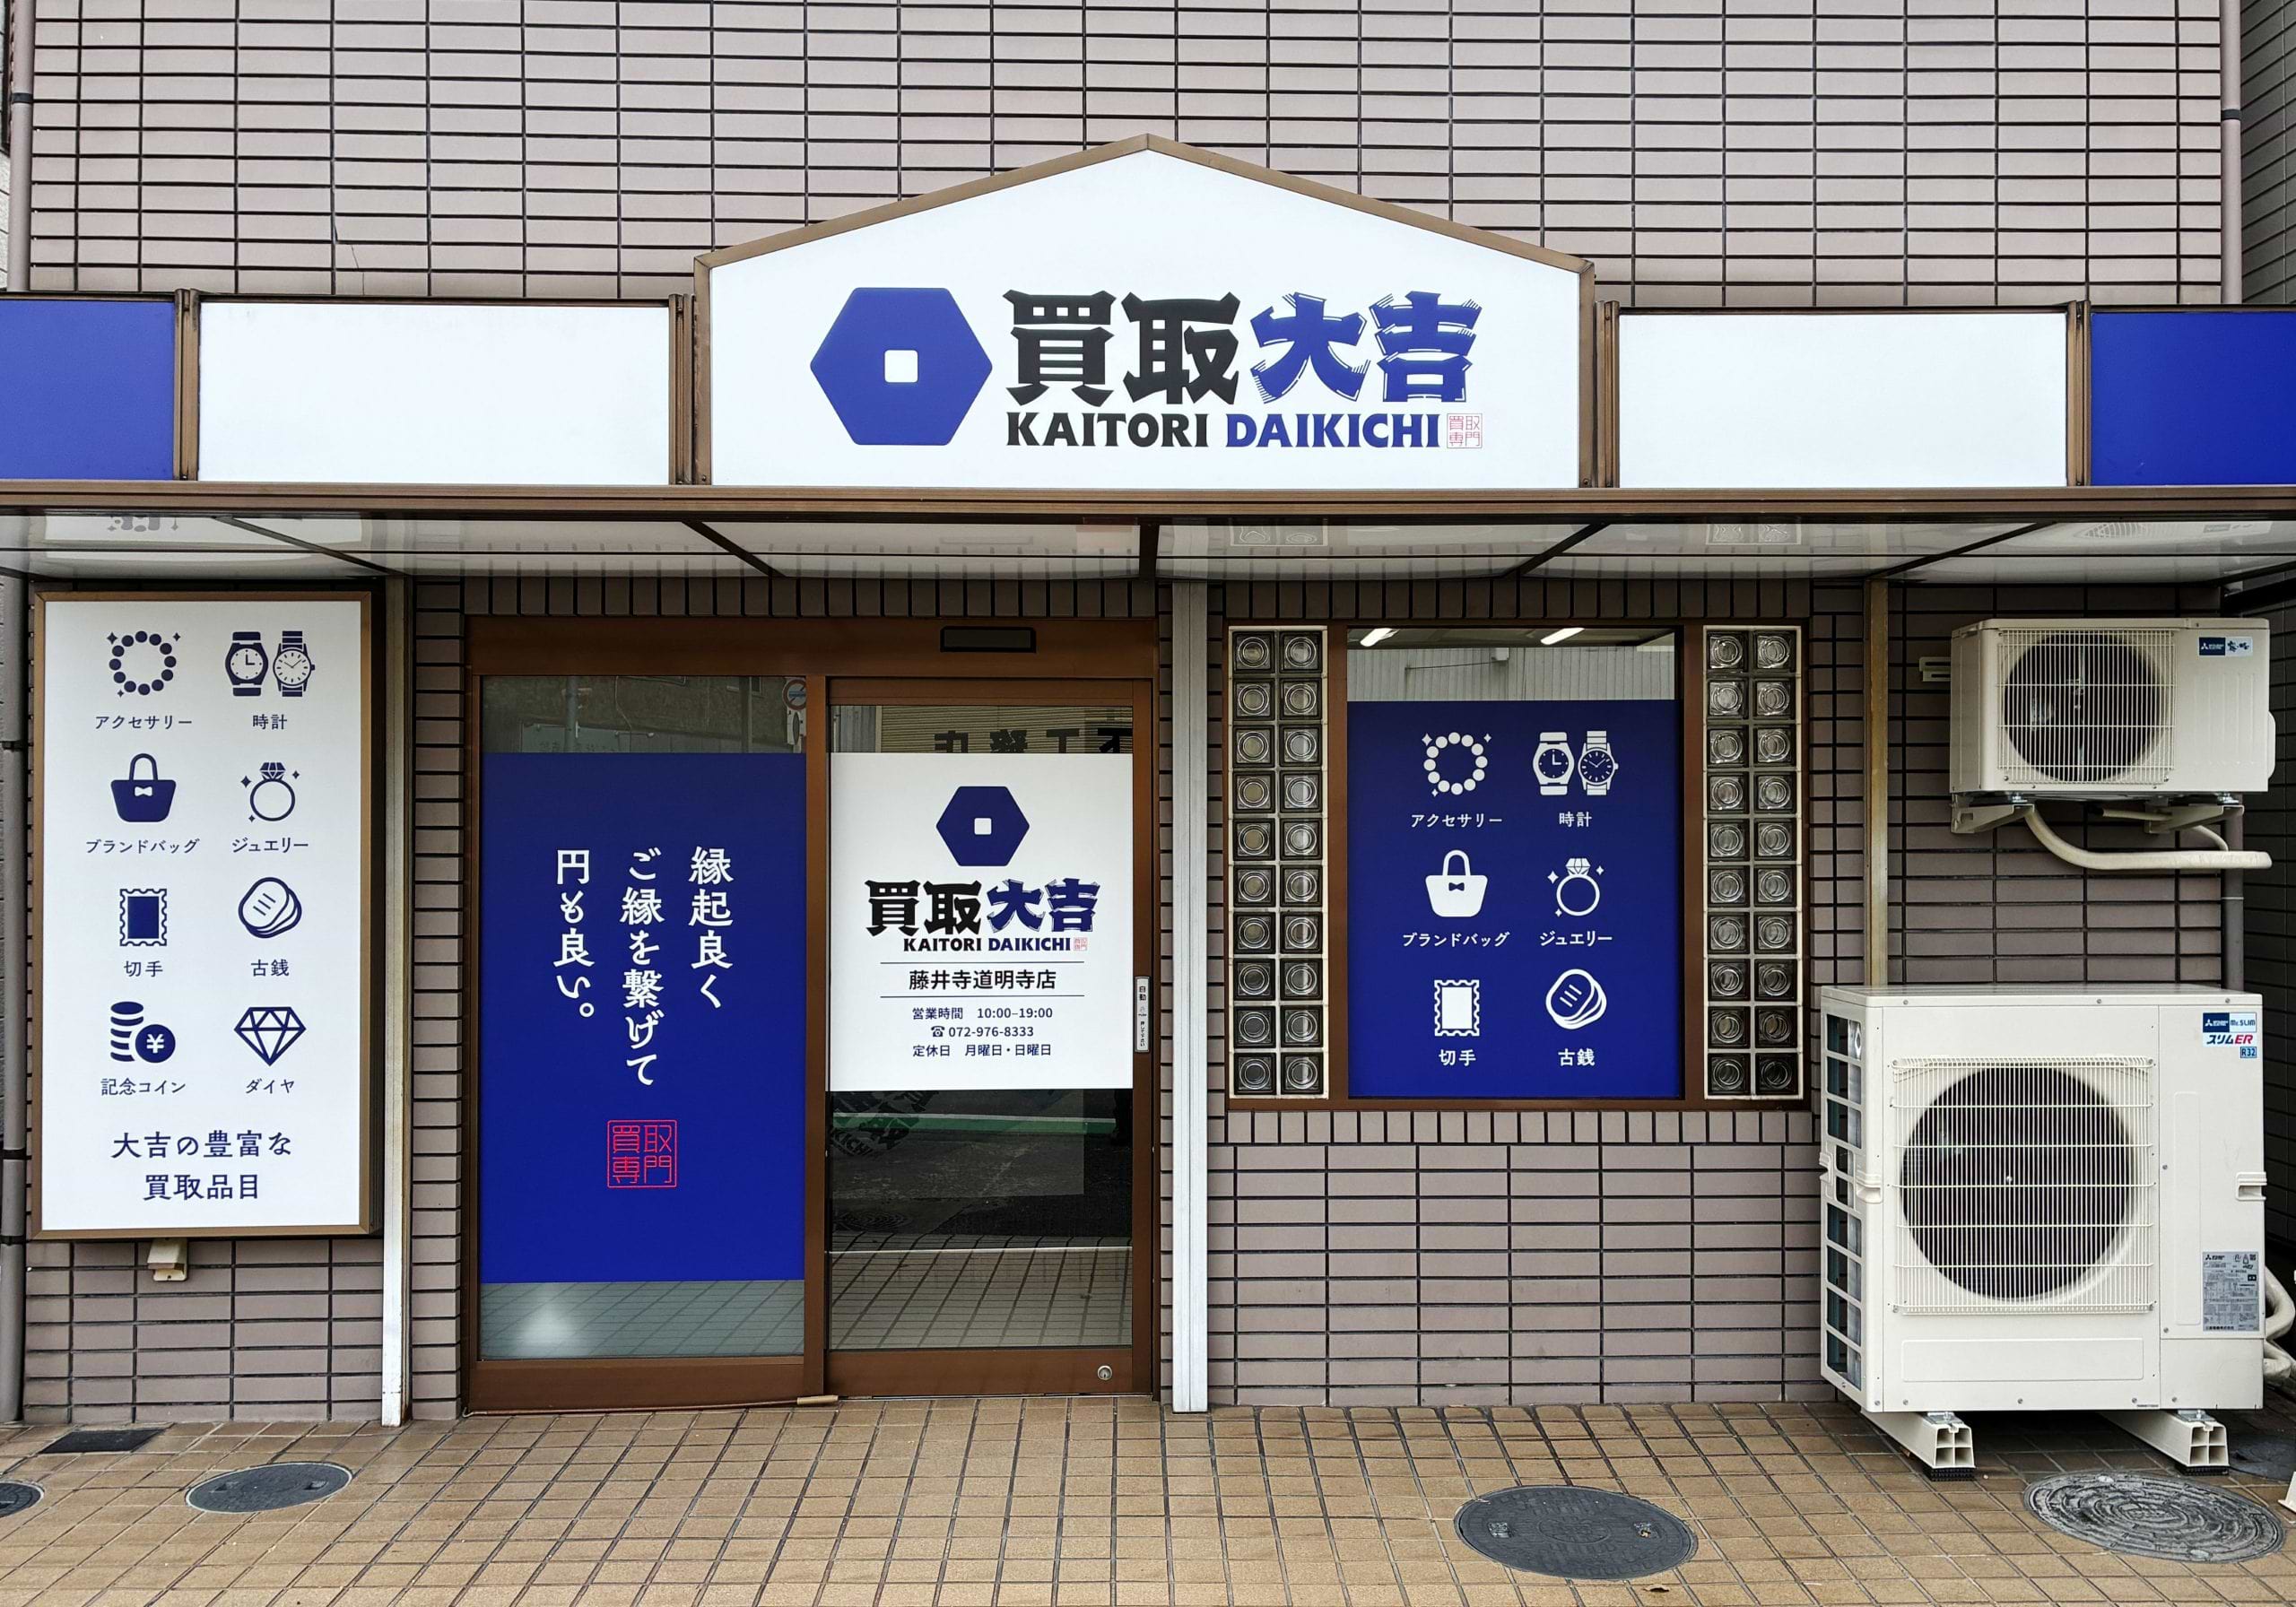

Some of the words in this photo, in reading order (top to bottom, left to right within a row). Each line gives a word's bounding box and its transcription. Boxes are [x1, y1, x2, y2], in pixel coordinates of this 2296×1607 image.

[1002, 289, 1483, 407] 買取大吉
[1006, 412, 1209, 447] KAITORI
[1225, 413, 1440, 448] DAIKICHI
[95, 715, 193, 730] アクセサリー
[252, 713, 288, 730] 時計
[1411, 812, 1502, 828] アクセサリー
[1559, 811, 1593, 828] 時計
[86, 838, 200, 855] ブランドバッグ
[232, 837, 309, 854] ジュエリー
[864, 877, 1101, 936] 買取大吉
[552, 849, 596, 1018] 円も良い。
[688, 846, 735, 1009] 縁起良く
[903, 937, 982, 952] KAITORI
[987, 937, 1071, 951] DAIKICHI
[1403, 931, 1510, 948] ブランドバッグ
[1539, 930, 1613, 947] ジュエリー
[123, 960, 163, 977] 切手
[250, 959, 290, 977] 古銭
[619, 847, 665, 1086] ご縁を繋げて
[909, 969, 1057, 990] 藤井寺道明寺店
[912, 1006, 963, 1021] 営業時間
[948, 1026, 1034, 1038] 072-976-8333
[912, 1044, 951, 1057] 定休日
[964, 1043, 1051, 1056] 月曜日・日曜日
[1438, 1048, 1476, 1067] 切手
[1558, 1047, 1596, 1066] 古銭
[2241, 1048, 2256, 1056] R32
[100, 1077, 186, 1096] 記念コイン
[246, 1078, 295, 1094] ダイヤ
[110, 1129, 291, 1159] 大吉の豊富な
[611, 1123, 673, 1154] 買取
[611, 1155, 673, 1186] 専門
[143, 1174, 258, 1201] 買取品目
